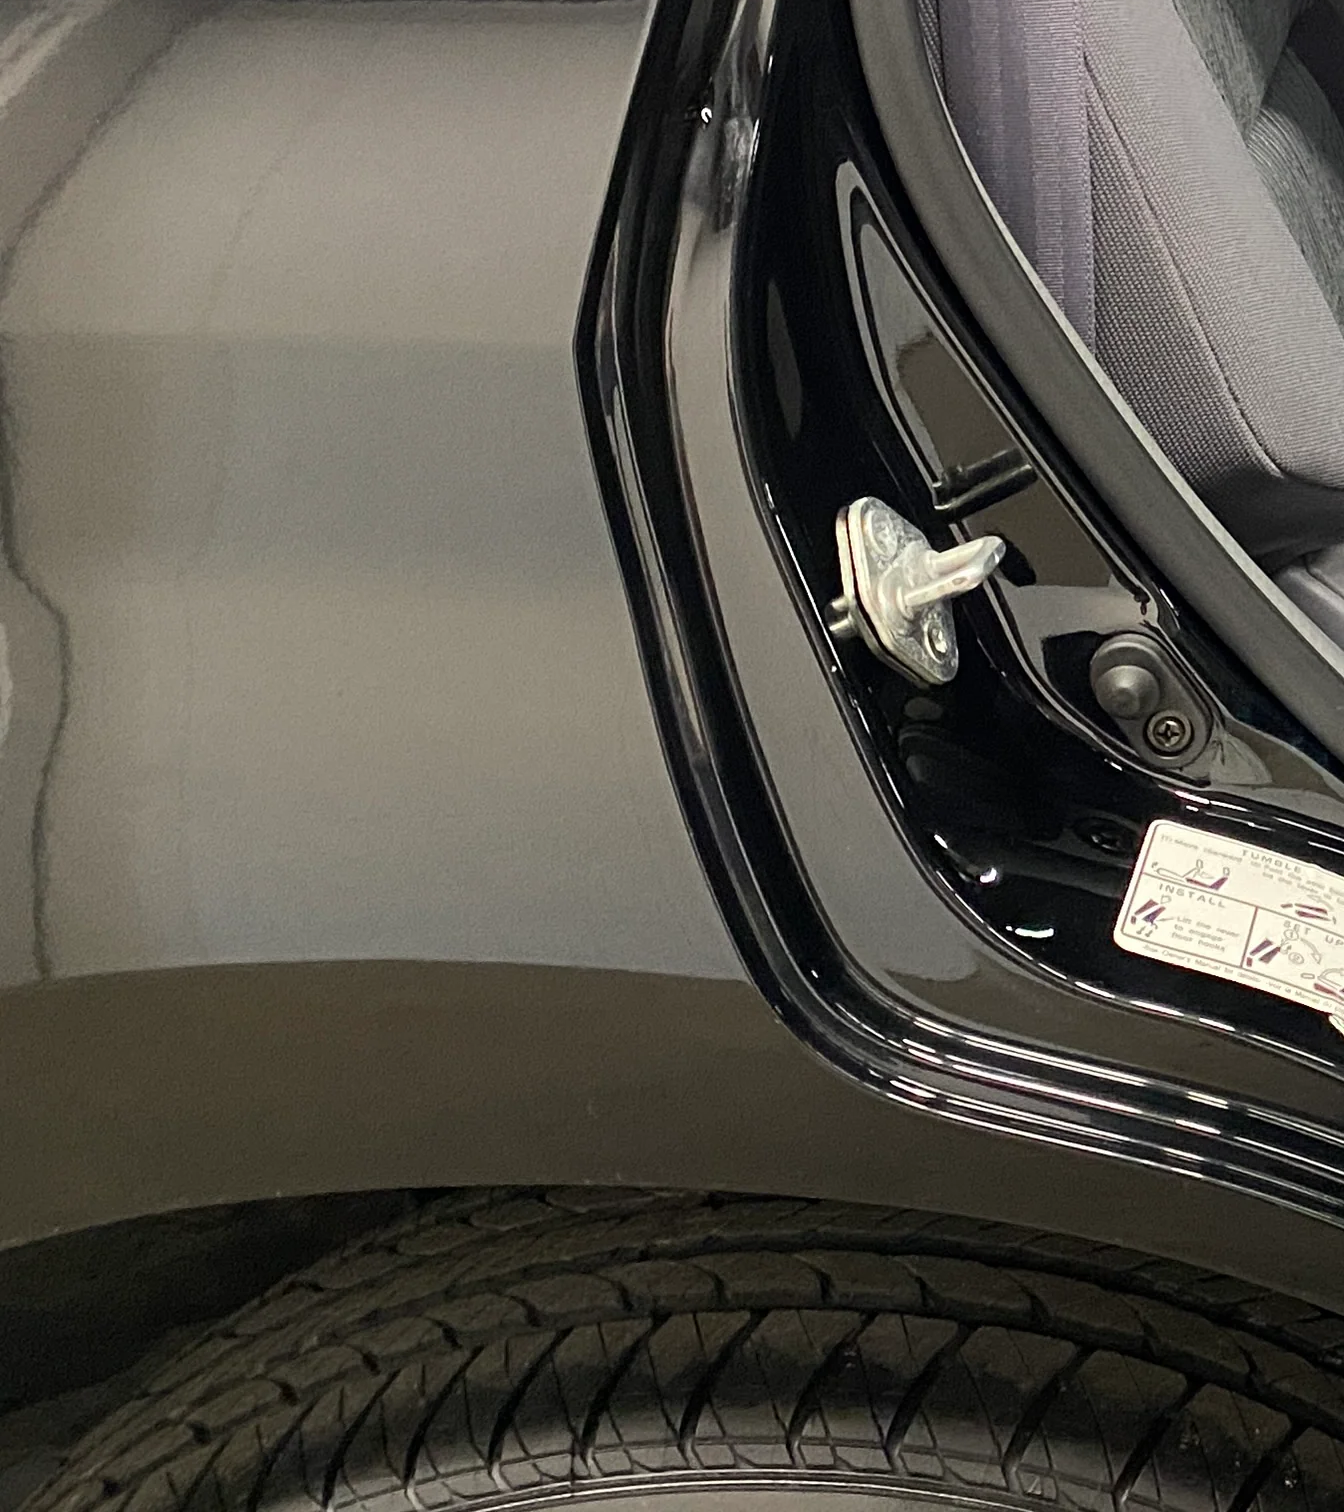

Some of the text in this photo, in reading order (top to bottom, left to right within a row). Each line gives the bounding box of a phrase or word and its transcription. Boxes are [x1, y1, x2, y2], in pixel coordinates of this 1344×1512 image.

[1241, 849, 1302, 872] TUMBLE
[1158, 882, 1226, 908] INSTALL
[1325, 935, 1344, 947] UP
